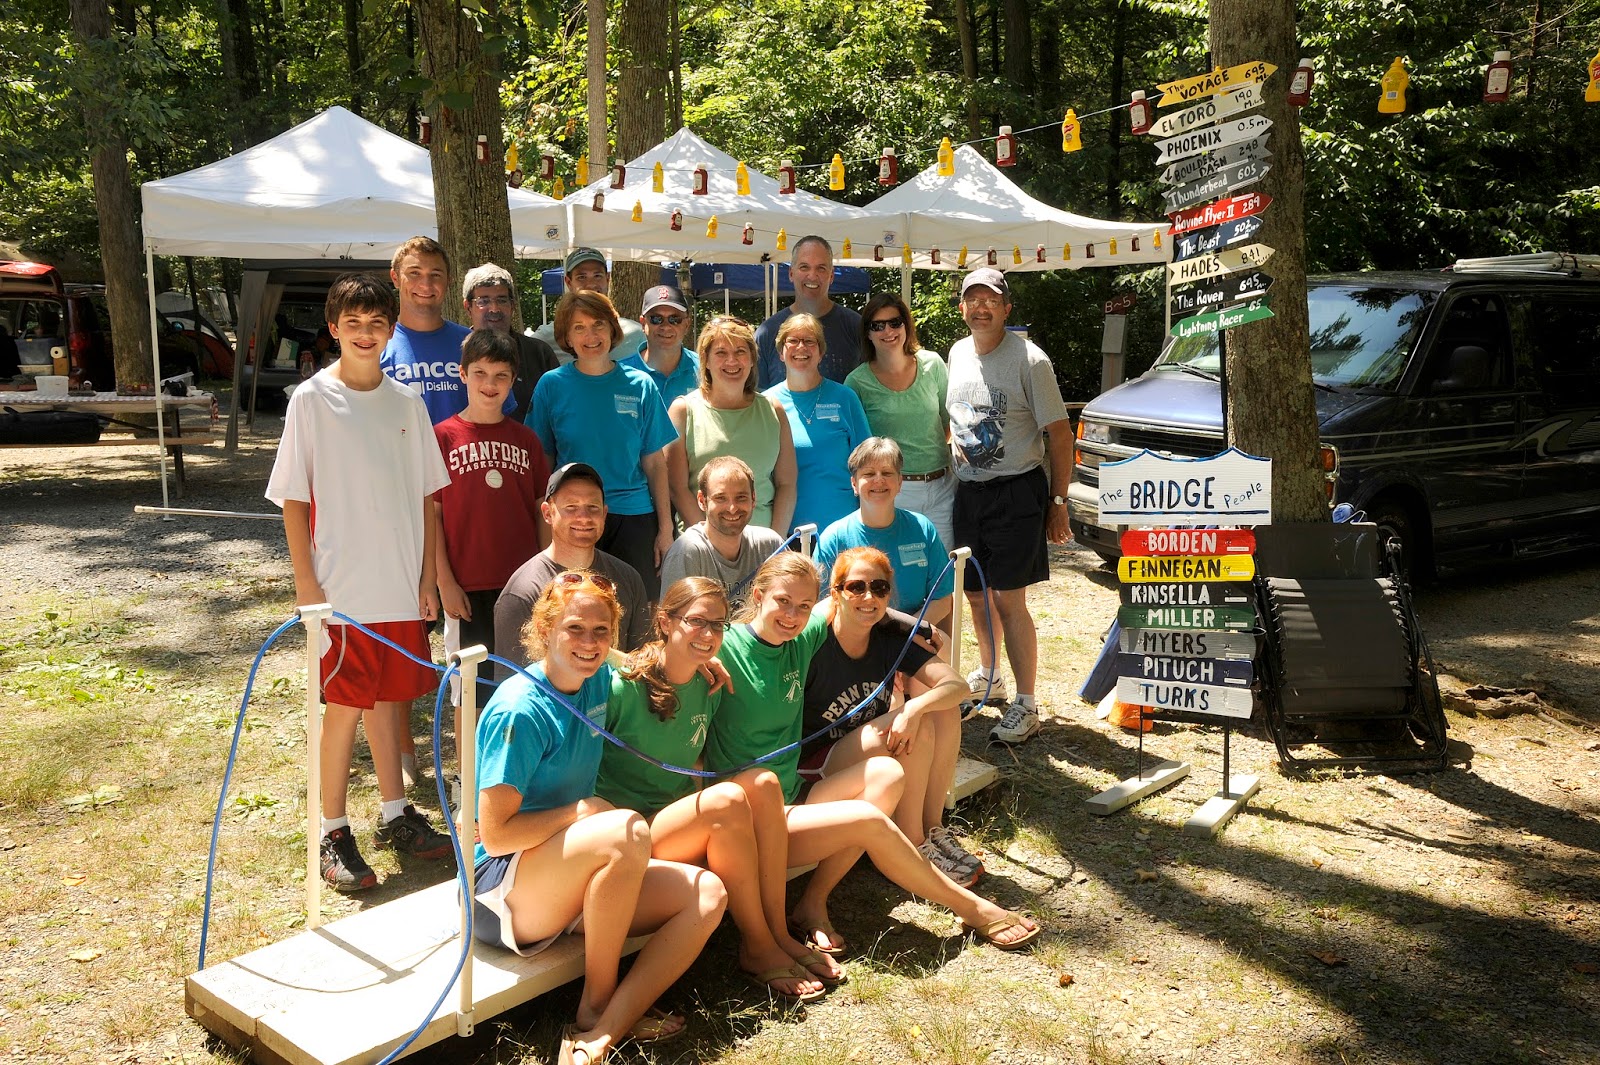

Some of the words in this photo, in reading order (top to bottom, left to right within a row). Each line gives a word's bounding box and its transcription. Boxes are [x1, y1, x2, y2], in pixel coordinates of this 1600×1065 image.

[1167, 84, 1185, 95] The
[1180, 70, 1229, 100] VOYAGE
[1244, 63, 1266, 79] 695
[1162, 122, 1175, 133] EL
[1178, 103, 1216, 128] TORO
[1235, 89, 1252, 103] 190
[1167, 129, 1222, 157] PHOENIX
[1237, 119, 1255, 132] 0.5
[1174, 150, 1216, 181] BOULDER
[1239, 140, 1259, 156] 248
[1169, 174, 1228, 207] Thunderhead
[1237, 163, 1257, 180] 605
[1174, 213, 1203, 232] Ravine
[1204, 207, 1226, 225] Flyer
[1242, 196, 1260, 214] 289
[1180, 239, 1196, 258] The
[1198, 232, 1221, 252] Beast
[1234, 218, 1251, 236] 502
[1181, 257, 1220, 279] HADES
[1241, 247, 1260, 265] 841
[1177, 294, 1194, 310] The
[1196, 290, 1224, 306] Raven
[1239, 273, 1260, 291] 695
[1180, 320, 1217, 338] Lightning
[1219, 313, 1245, 328] Racer
[1249, 299, 1262, 312] 65
[382, 361, 460, 381] cance
[426, 380, 459, 392] Dislike
[449, 441, 530, 471] STANFORD
[459, 460, 525, 475] BASKETBALL
[1100, 487, 1124, 506] The
[1130, 476, 1216, 510] BRIDGE
[1223, 481, 1263, 509] People
[1147, 531, 1217, 554] BORDEN
[1129, 558, 1221, 579] FINNEGAN
[1131, 584, 1210, 605] KINSELLA
[1147, 608, 1216, 628] MILLER
[1143, 631, 1208, 655] MYERS
[1143, 656, 1214, 683] PITUCH
[821, 683, 861, 724] PENN
[1139, 683, 1210, 711] TURKS
